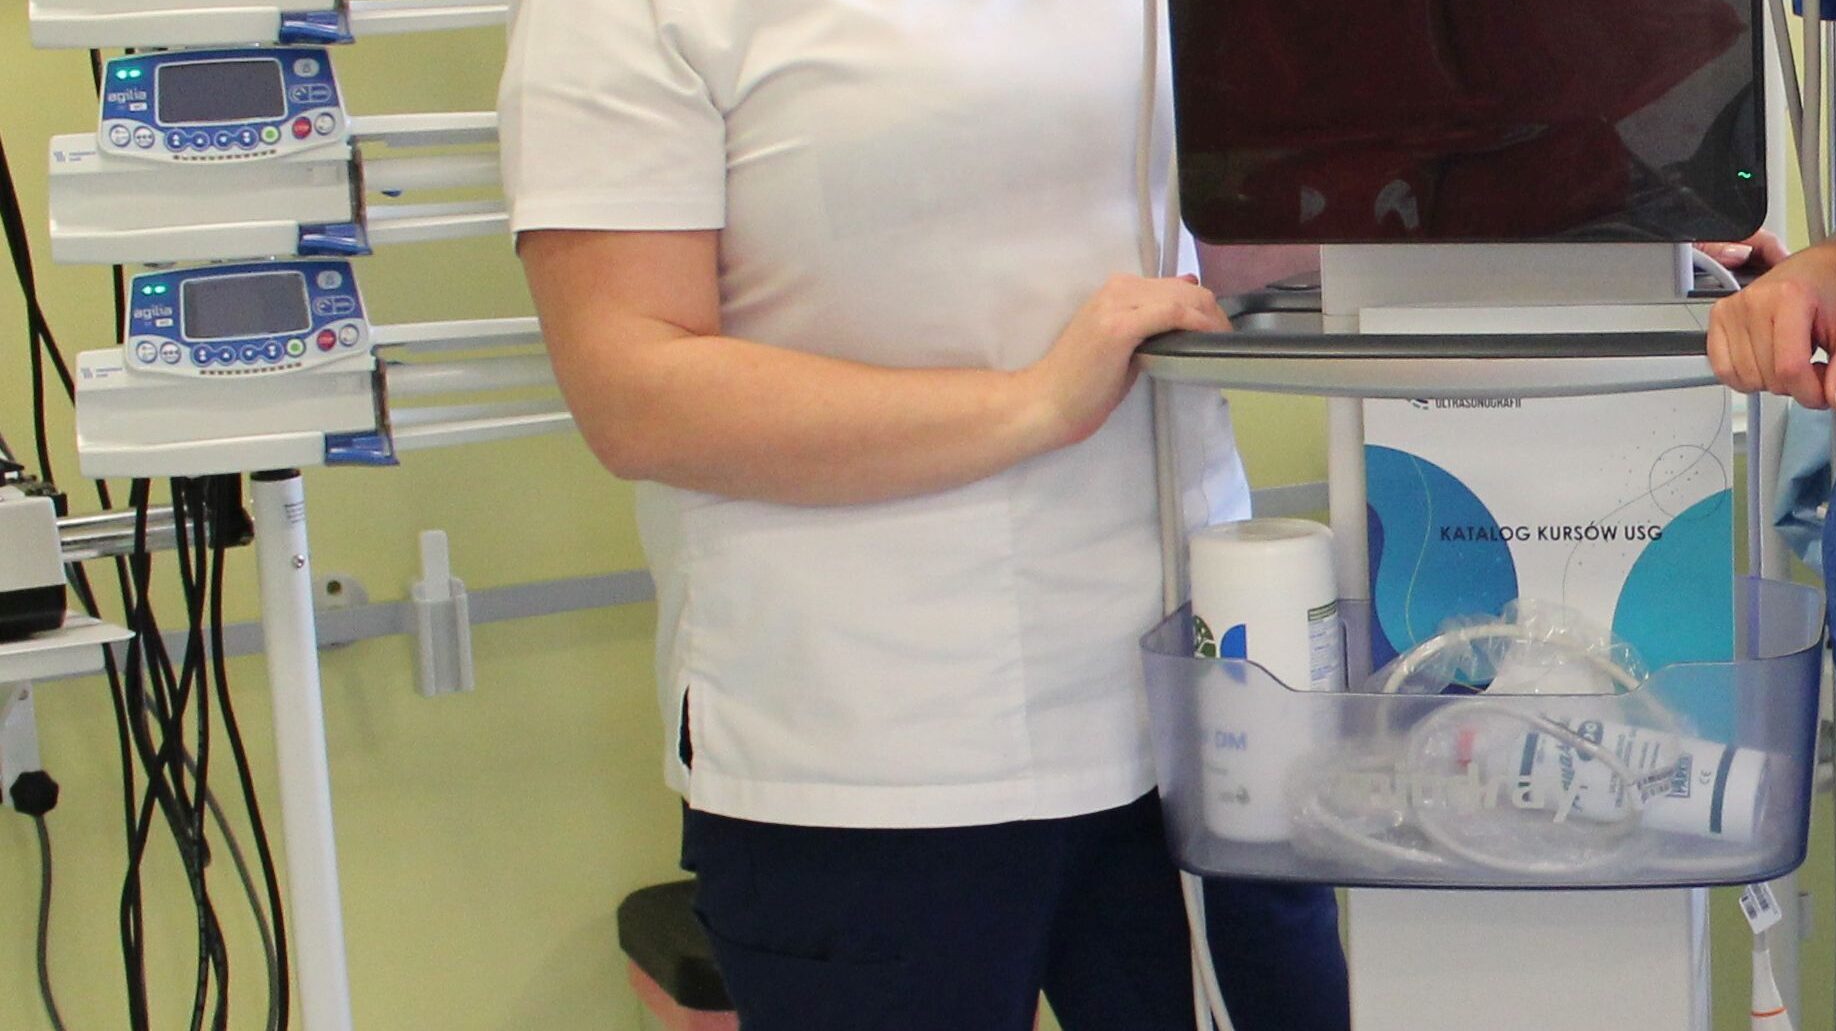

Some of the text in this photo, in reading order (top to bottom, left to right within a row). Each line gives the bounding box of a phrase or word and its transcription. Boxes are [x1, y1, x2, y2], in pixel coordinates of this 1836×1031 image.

[107, 87, 148, 104] agilia
[132, 304, 173, 321] agilia
[1440, 520, 1663, 543] KATALOG KURSÓW USG
